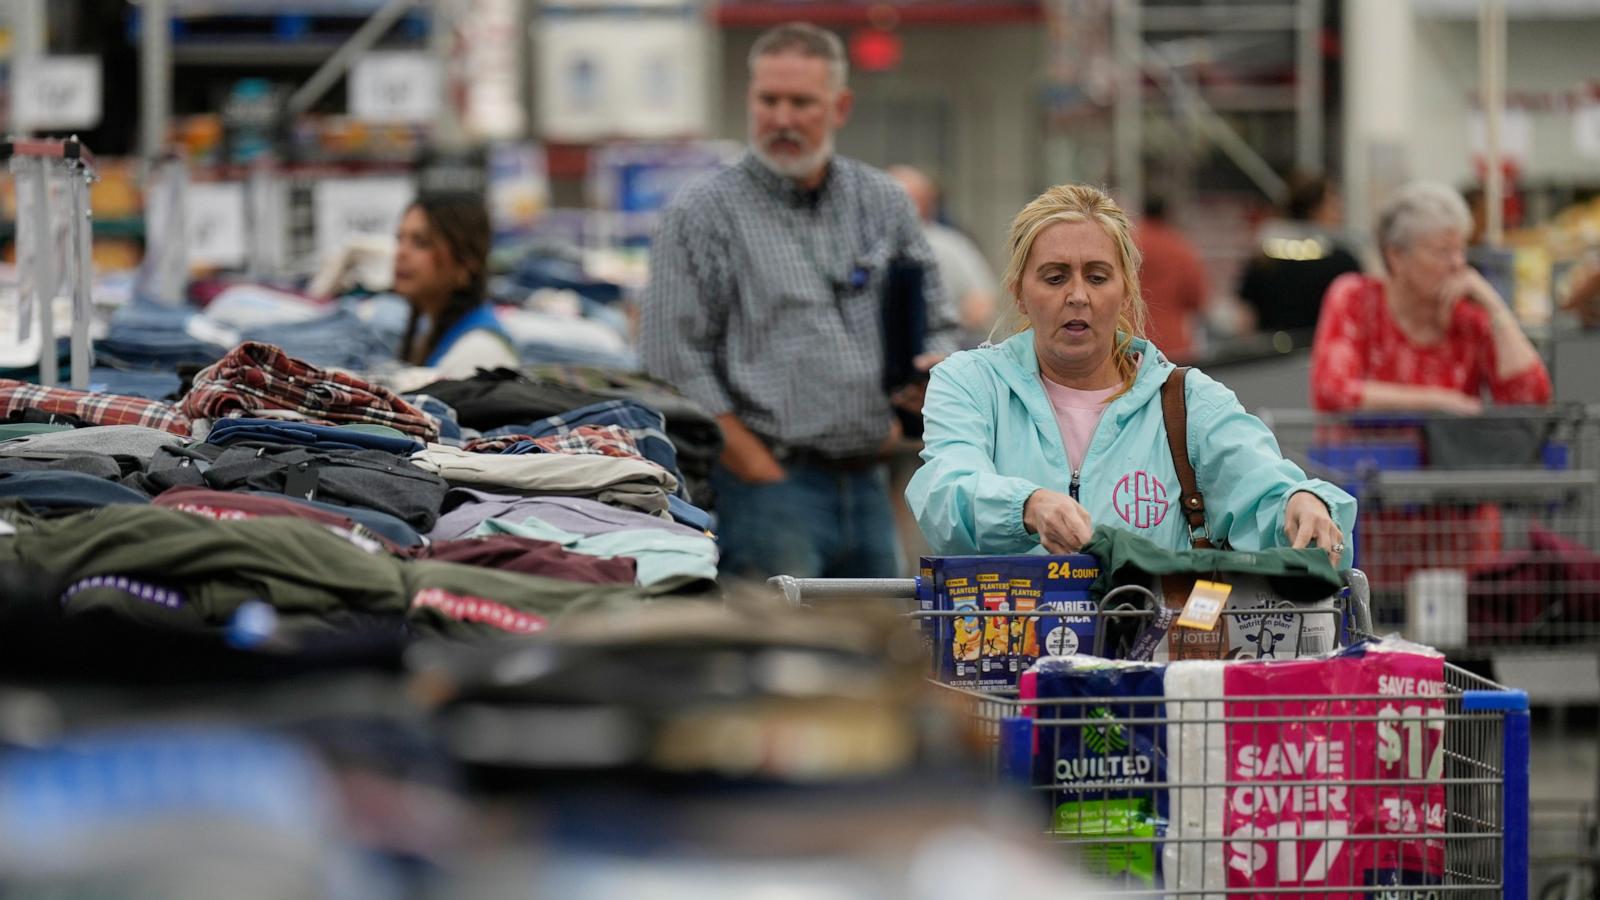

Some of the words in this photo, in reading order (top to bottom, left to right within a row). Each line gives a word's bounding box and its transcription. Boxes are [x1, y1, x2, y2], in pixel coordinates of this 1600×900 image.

[1048, 562, 1071, 579] 24
[1072, 569, 1099, 578] COUNT
[949, 586, 979, 596] PLANTERS
[980, 582, 1010, 591] PLANTERS
[1011, 588, 1041, 598] PLANTERS
[1172, 632, 1224, 644] POTEIN
[1378, 675, 1415, 697] SAVE
[1378, 702, 1445, 780] $17
[1056, 755, 1151, 780] QUILTED
[1236, 741, 1345, 777] SAVE
[1233, 782, 1348, 815] OVER
[1229, 820, 1348, 881] $17
